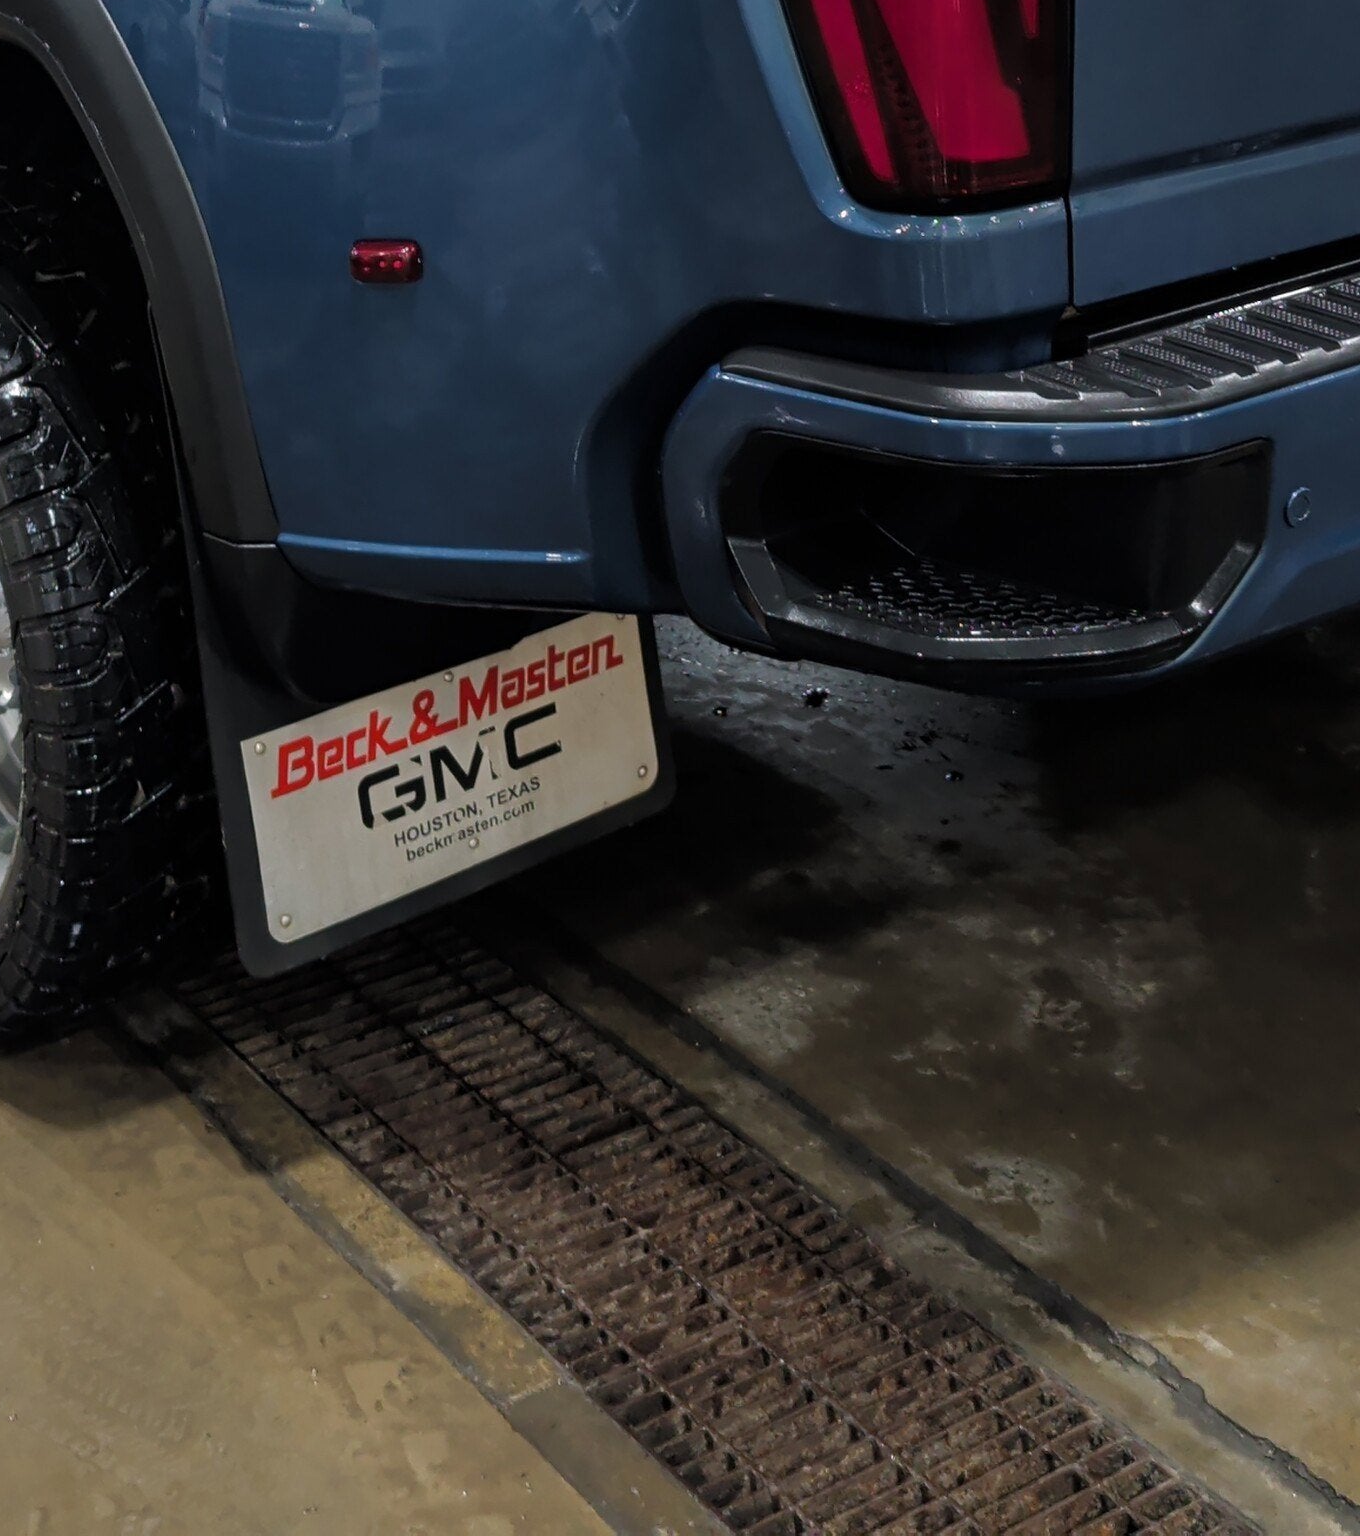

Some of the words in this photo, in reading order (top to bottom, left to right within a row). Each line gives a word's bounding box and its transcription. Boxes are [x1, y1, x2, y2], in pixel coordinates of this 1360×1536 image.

[270, 709, 409, 800] Beck
[409, 689, 458, 745] &
[458, 634, 624, 728] Masten
[357, 702, 563, 830] GMC
[394, 801, 483, 848] HOUSTON,
[486, 776, 541, 808] TEXAS
